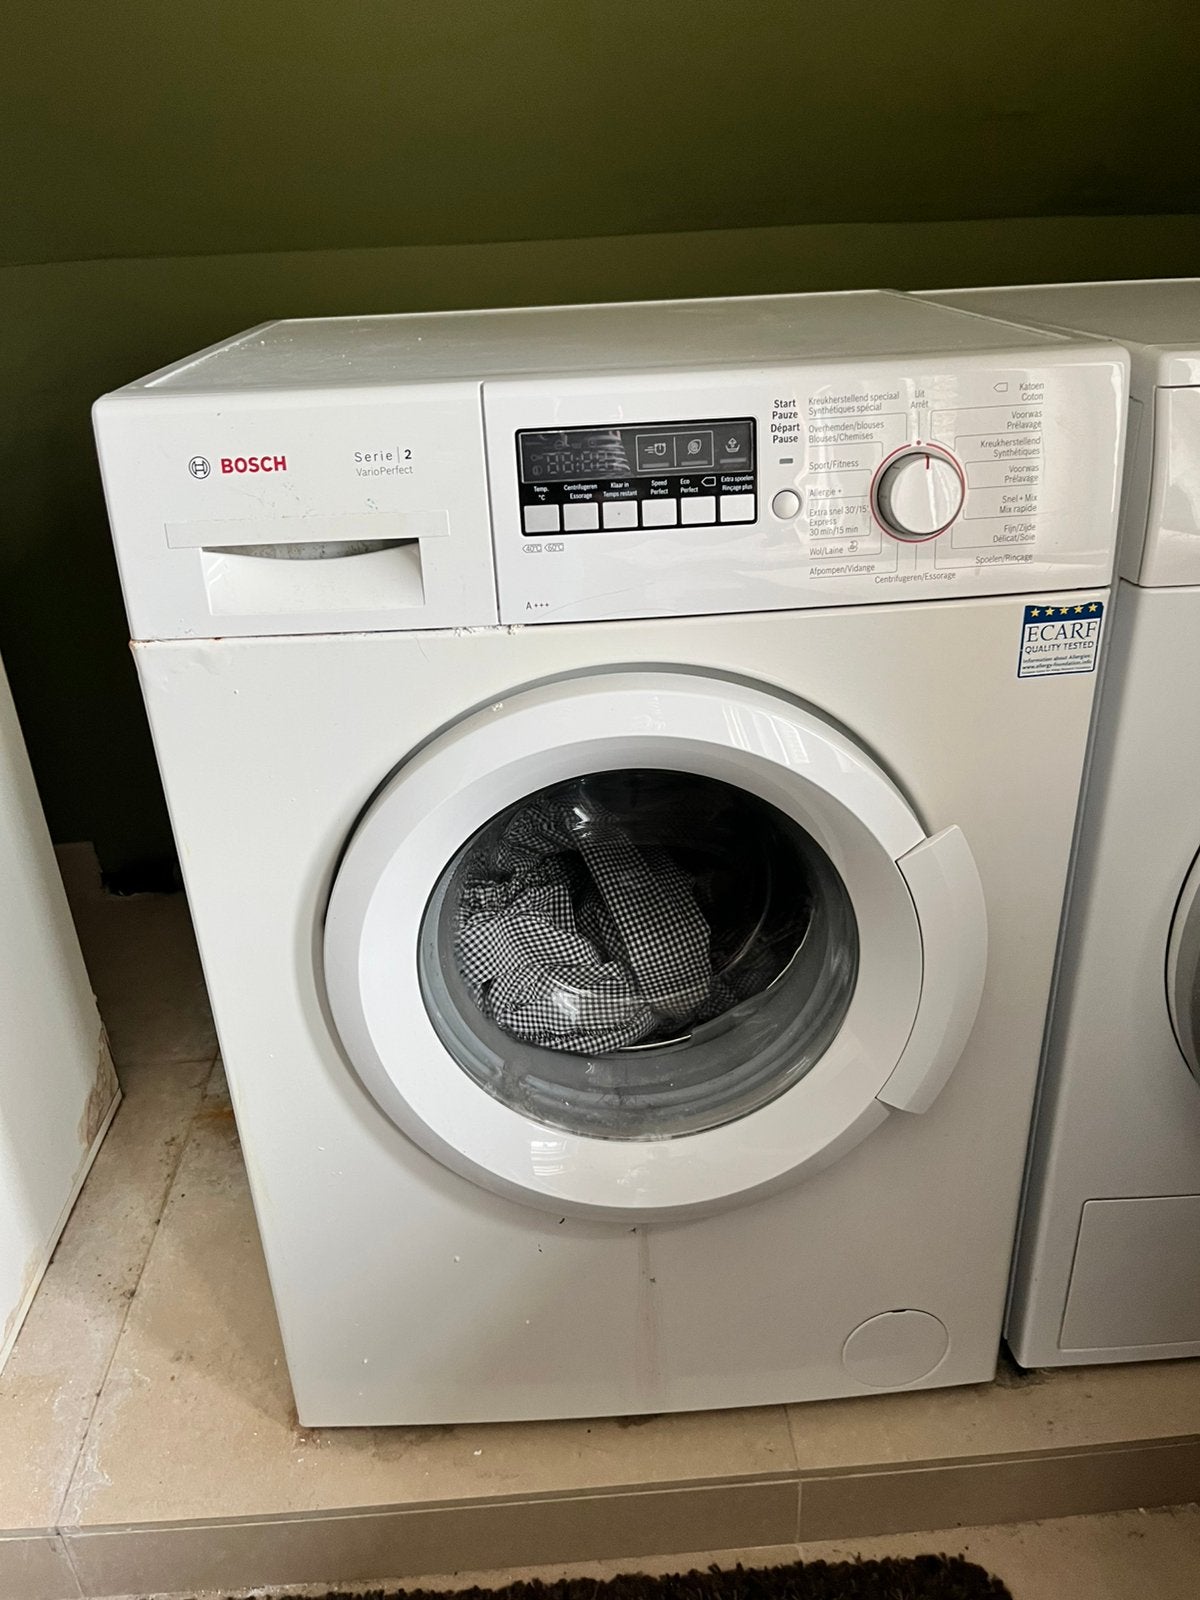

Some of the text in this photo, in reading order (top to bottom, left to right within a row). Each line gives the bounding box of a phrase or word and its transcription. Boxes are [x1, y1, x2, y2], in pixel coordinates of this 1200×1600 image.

[1019, 382, 1044, 391] Katoen
[808, 391, 900, 405] Kreukherstellend speciaal
[914, 390, 925, 398] Uit
[1021, 393, 1044, 401] Coton
[773, 399, 796, 408] Start
[910, 400, 929, 409] Arrêt
[808, 403, 882, 416] Synthétiques spécial
[1011, 410, 1042, 419] Voorwas
[772, 410, 798, 420] Pauze
[770, 423, 800, 434] Départ
[808, 421, 885, 433] Overhemden/blouses
[1006, 421, 1042, 431] Prélavage
[772, 434, 798, 444] Pause
[808, 432, 874, 443] Blouses/Chemises
[980, 436, 1041, 449] Kreukherstellend
[354, 449, 412, 462] Serie 2
[993, 448, 1041, 459] Synthétiques
[220, 455, 287, 473] BOSCH
[808, 459, 860, 471] Sport/Fitness
[1009, 464, 1039, 473] Voorwas
[355, 465, 414, 477] VarioPerfect
[651, 479, 667, 488] Speed
[1004, 475, 1039, 485] Prélavage
[650, 488, 669, 496] Perfect
[680, 486, 699, 494] Perfect
[809, 488, 836, 497] Allergie
[1002, 494, 1019, 504] Snel
[809, 508, 828, 517] Extra
[1013, 504, 1037, 514] rapide
[809, 518, 837, 527] Express
[1003, 523, 1036, 533] Fijn/Zijde
[993, 533, 1036, 544] Délicat/Soie
[809, 547, 844, 557] Wol/Laine
[975, 553, 1033, 564] Spoelen/Rinçage
[809, 564, 875, 576] Afpompen/Vidange
[874, 572, 956, 584] Centrifugeren/Essorage
[1026, 621, 1098, 642] ECARF
[1025, 640, 1094, 654] QUALITY TESTED
